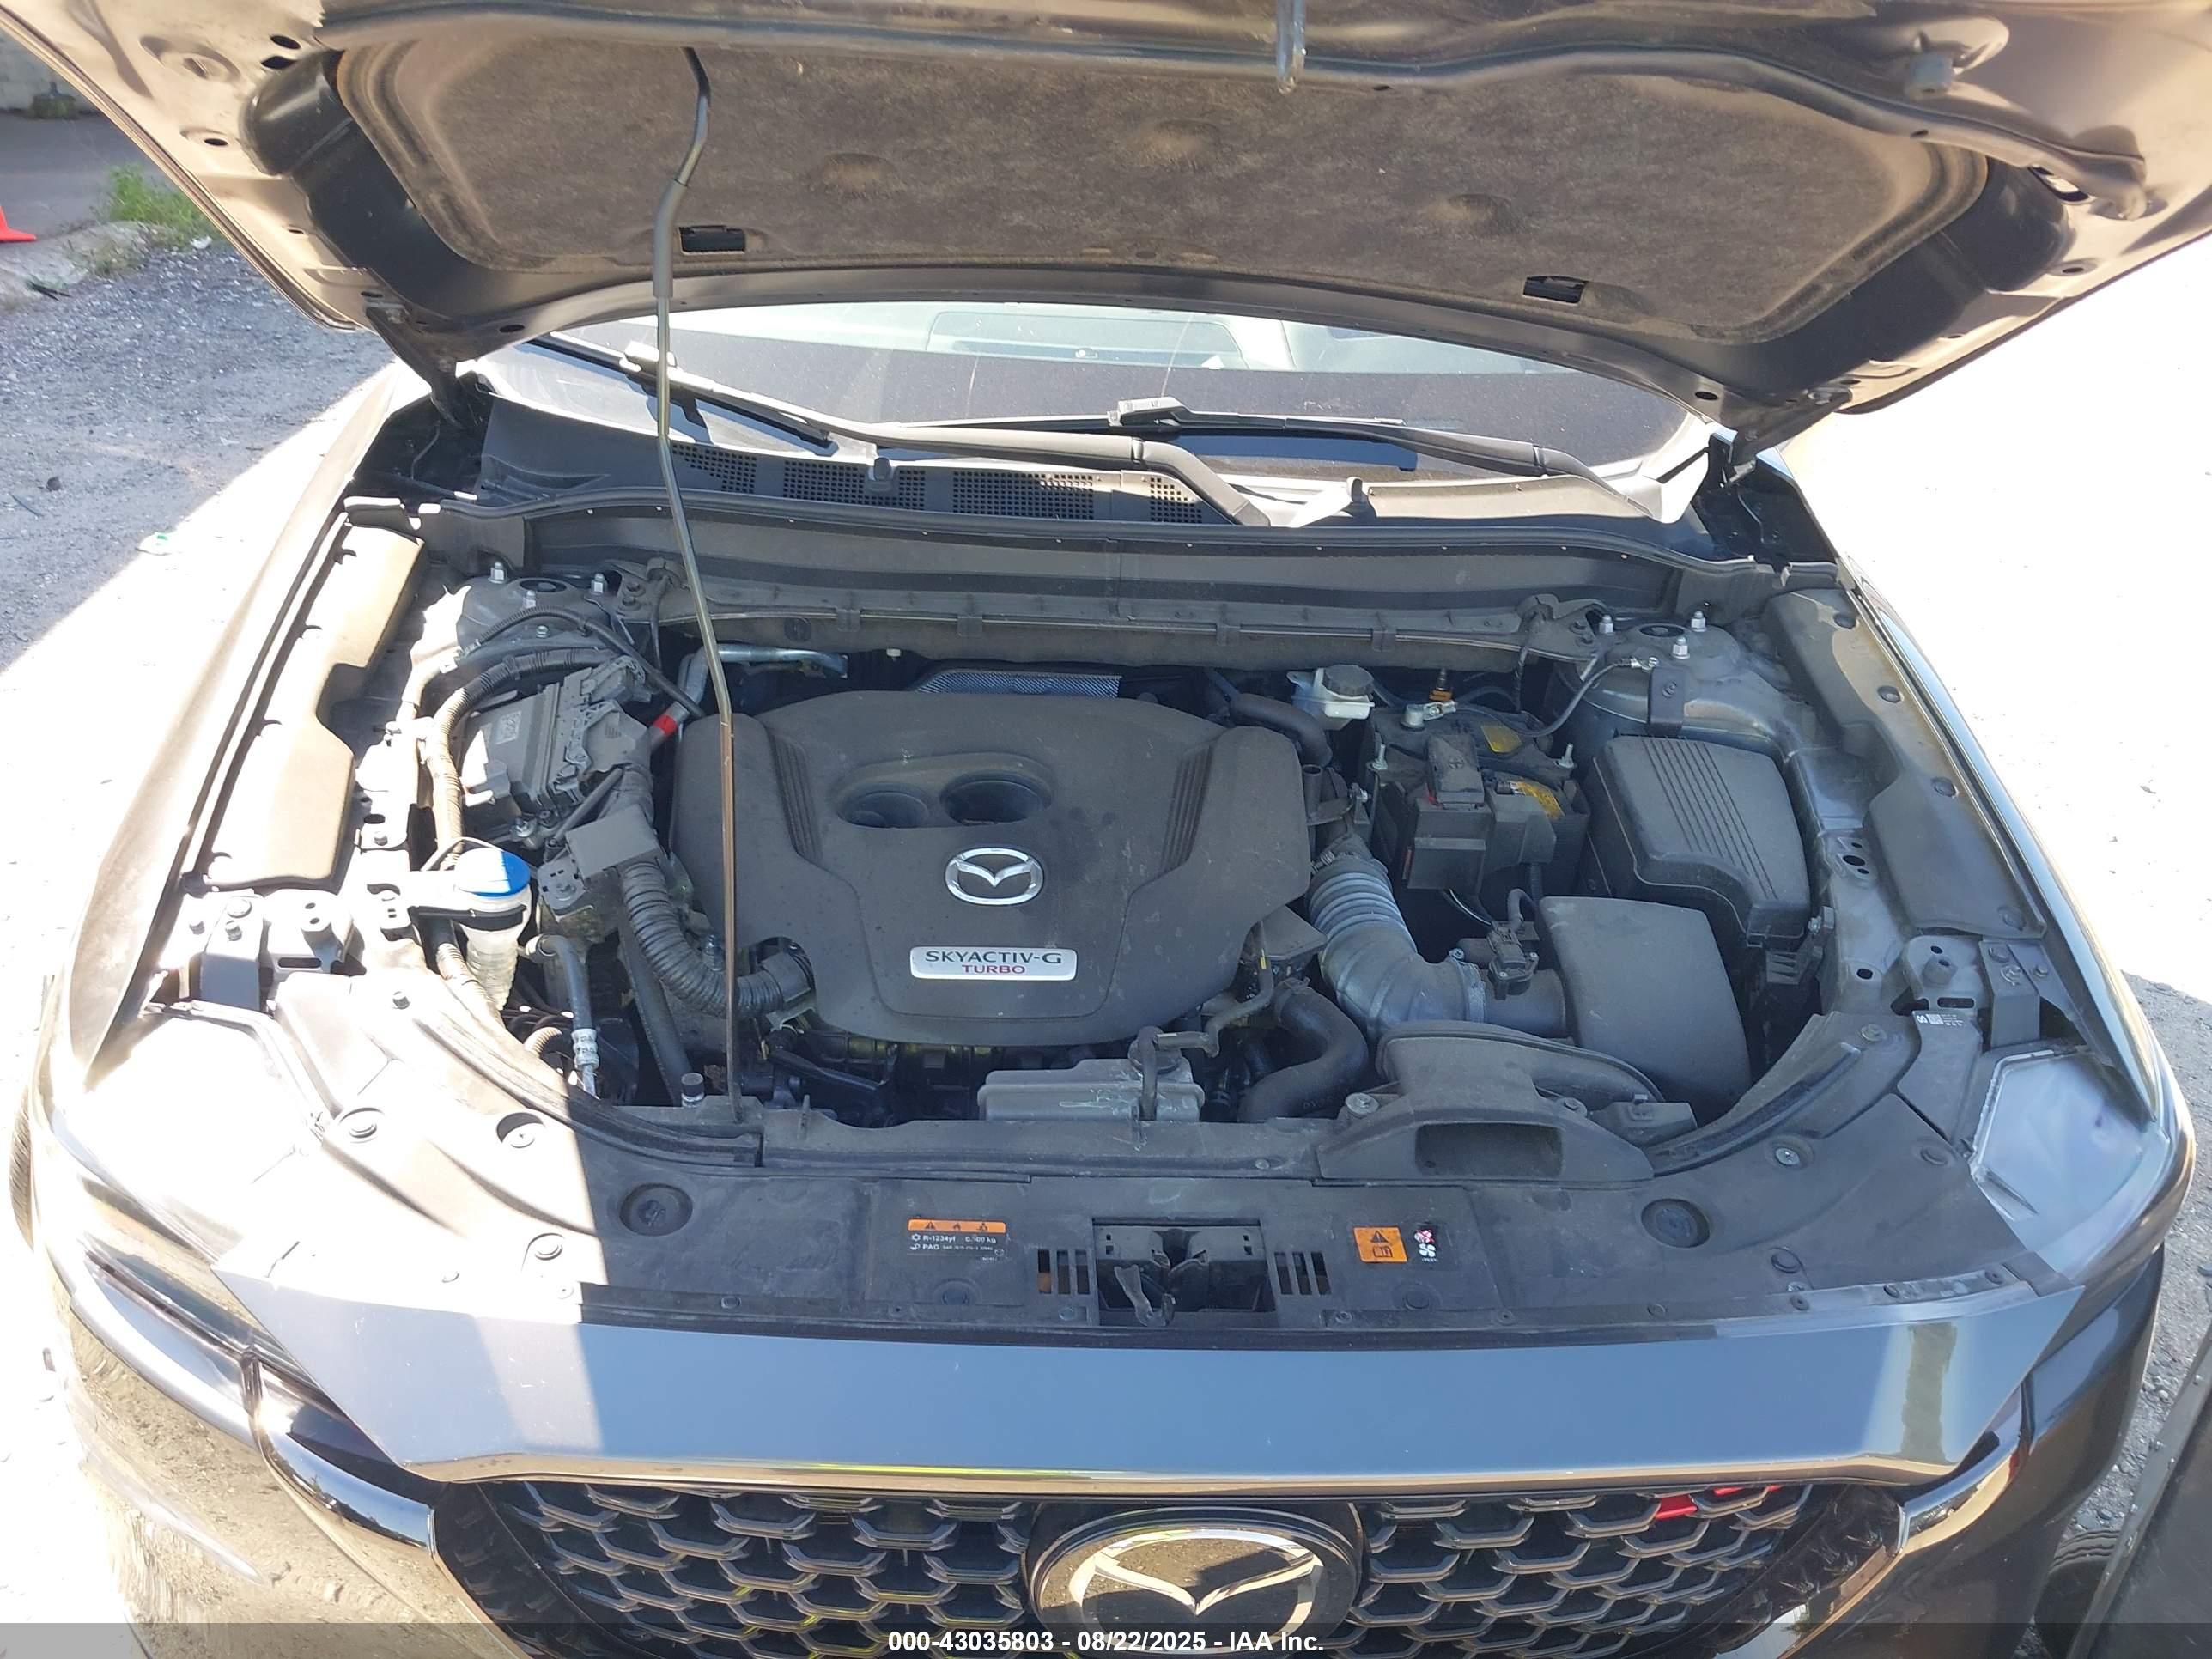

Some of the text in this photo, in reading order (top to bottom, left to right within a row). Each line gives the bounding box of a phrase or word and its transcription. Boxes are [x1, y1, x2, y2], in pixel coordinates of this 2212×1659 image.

[925, 951, 1062, 964] SKYACTIV-G
[962, 964, 1026, 974] TURBO
[922, 1235, 956, 1243] R-1234yf
